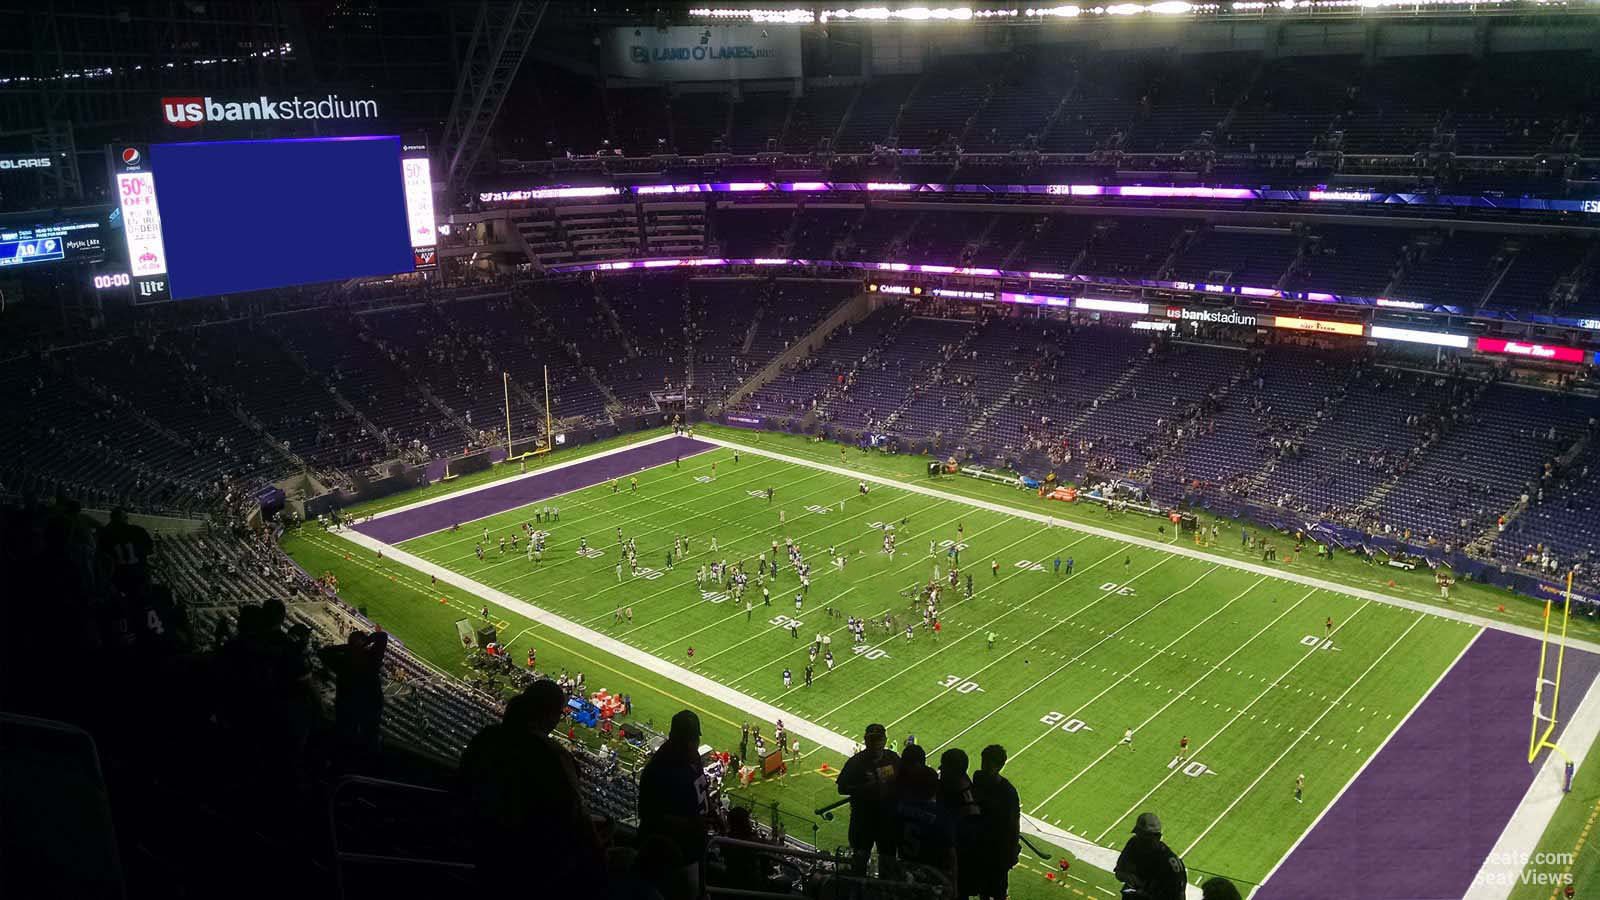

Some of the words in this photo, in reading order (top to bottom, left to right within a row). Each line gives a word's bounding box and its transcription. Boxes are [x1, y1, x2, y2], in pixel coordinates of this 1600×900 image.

[653, 48, 690, 61] LAND
[0, 158, 51, 169] OLARIS
[94, 274, 130, 289] 00:00
[140, 281, 164, 296] Lite
[146, 607, 165, 635] 4
[851, 645, 887, 660] 40
[938, 675, 979, 694] 30
[1040, 711, 1086, 733] 20
[1167, 756, 1209, 777] 10
